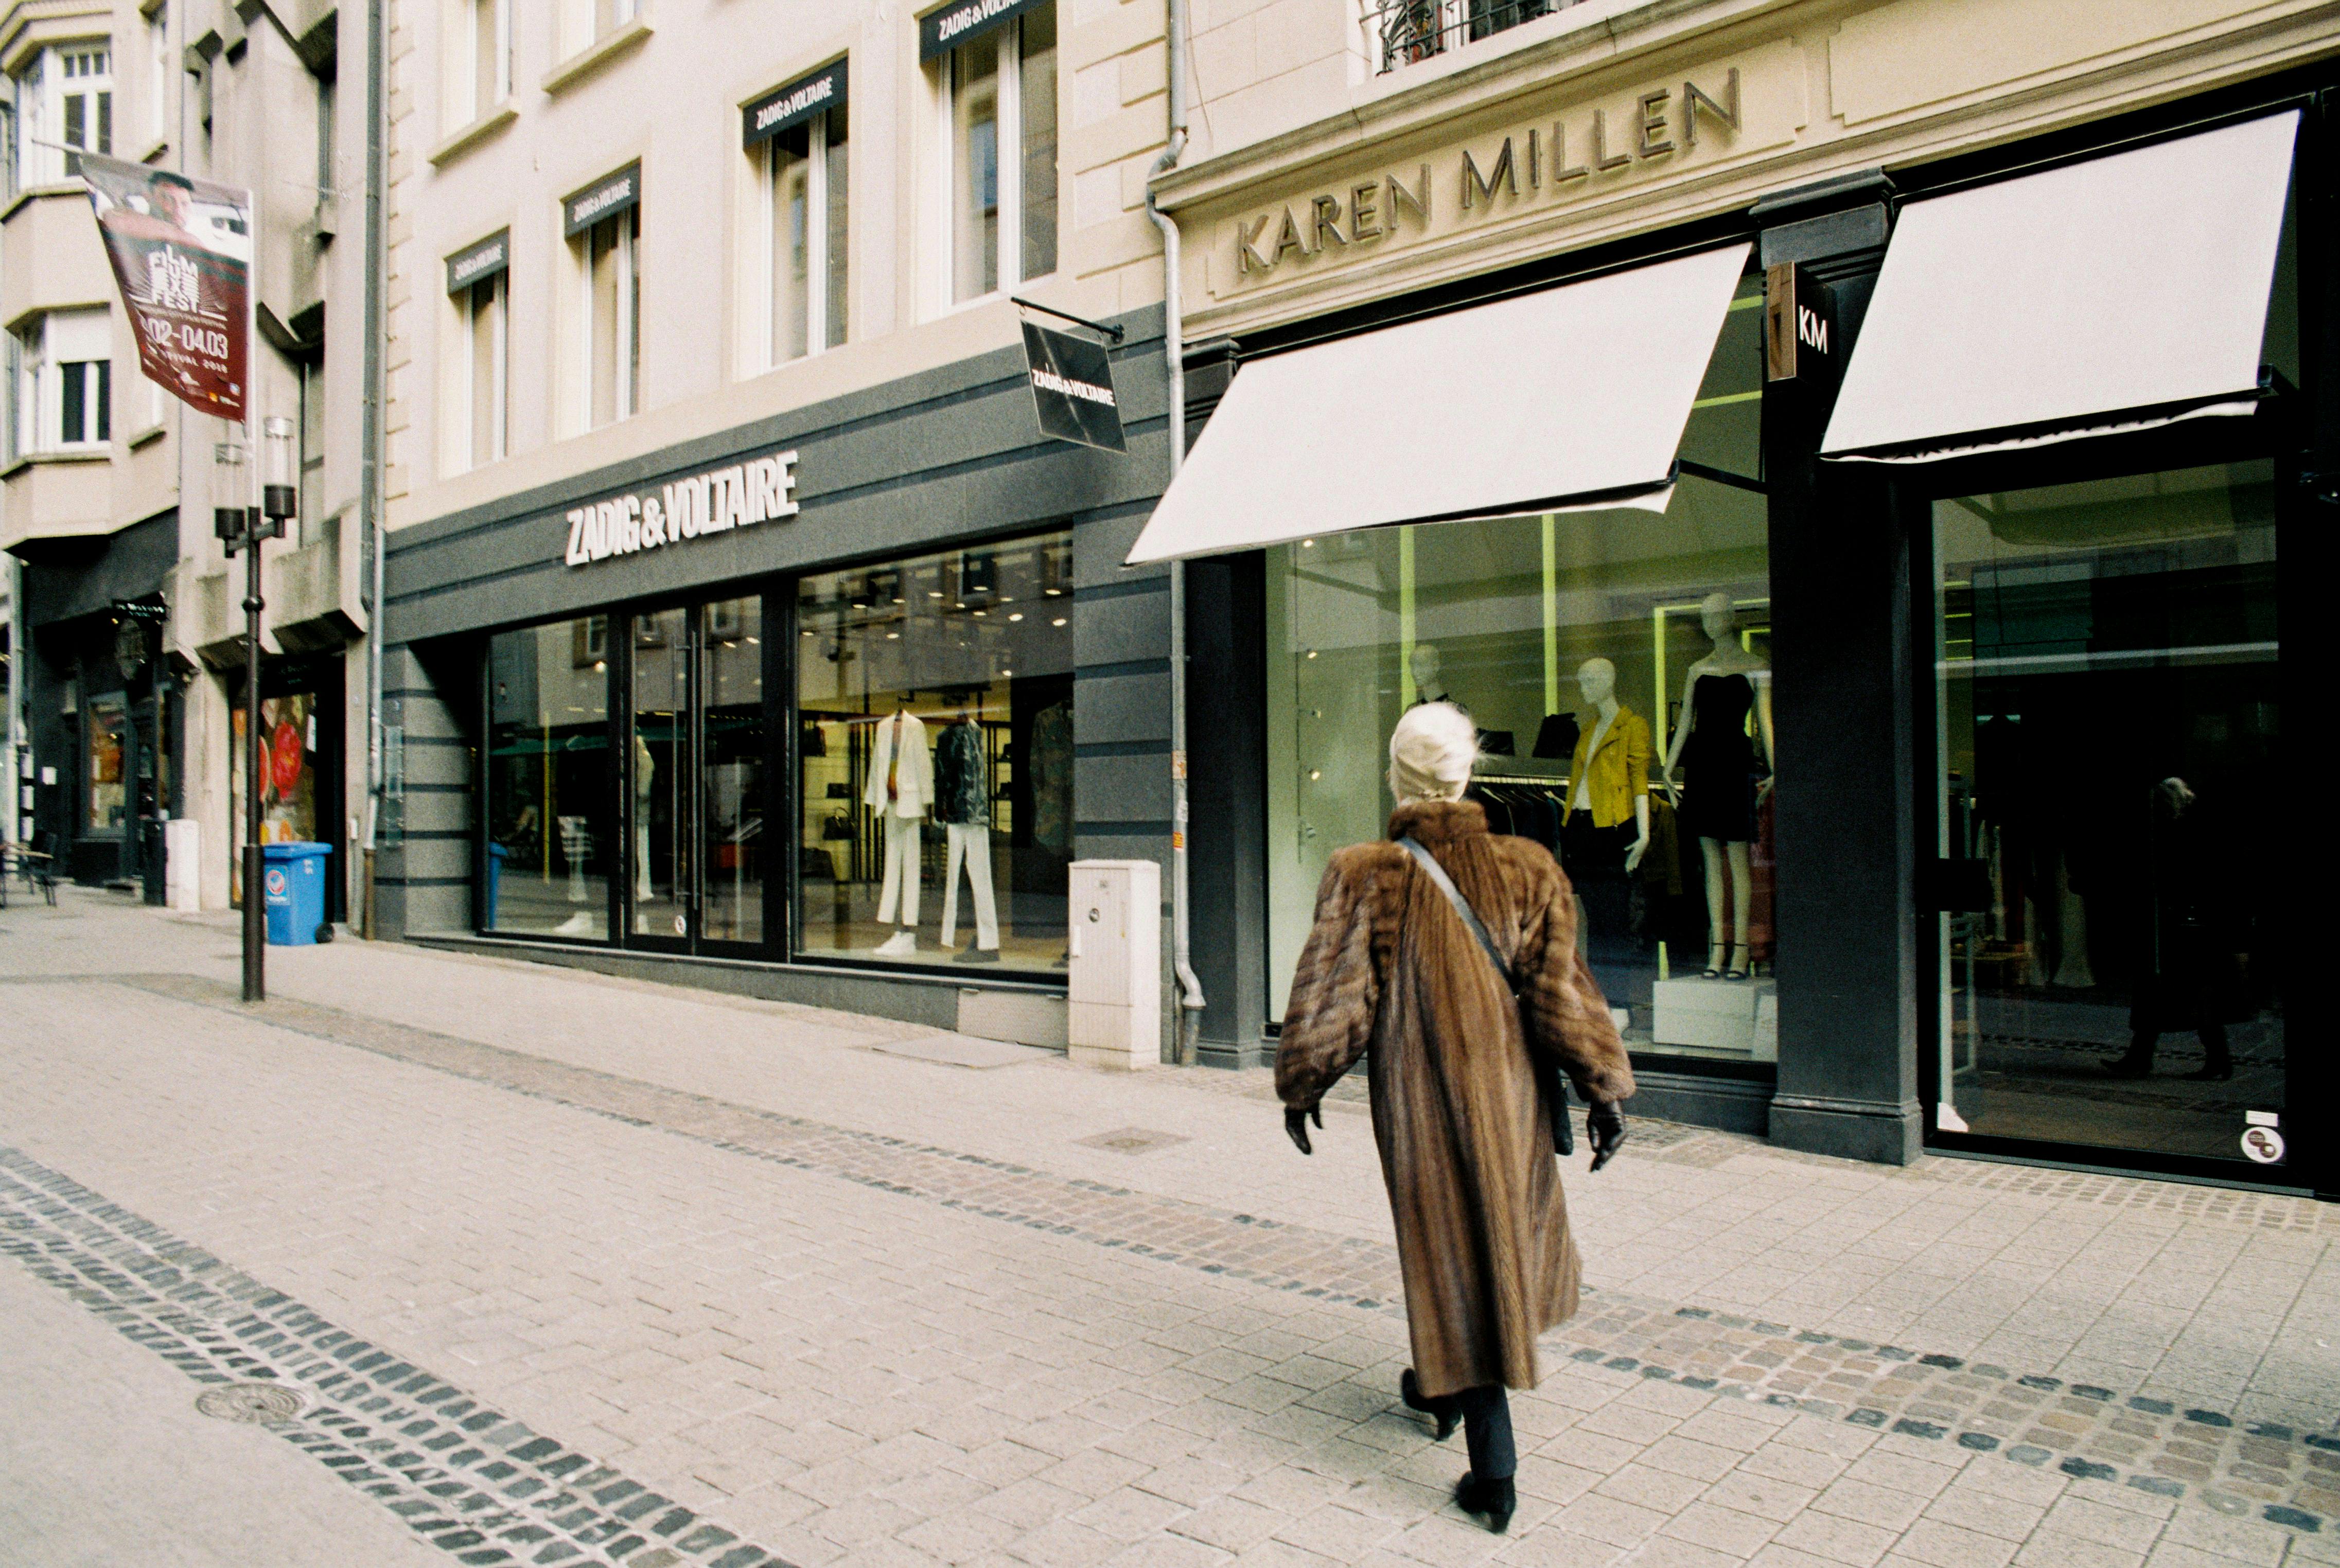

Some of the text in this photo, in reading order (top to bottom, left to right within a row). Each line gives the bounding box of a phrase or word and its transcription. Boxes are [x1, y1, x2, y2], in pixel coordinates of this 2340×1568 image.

[1236, 67, 1742, 273] KAREN MILLEN
[1800, 305, 1827, 354] KM
[566, 450, 799, 566] ZADIG&VOLTAIRE
